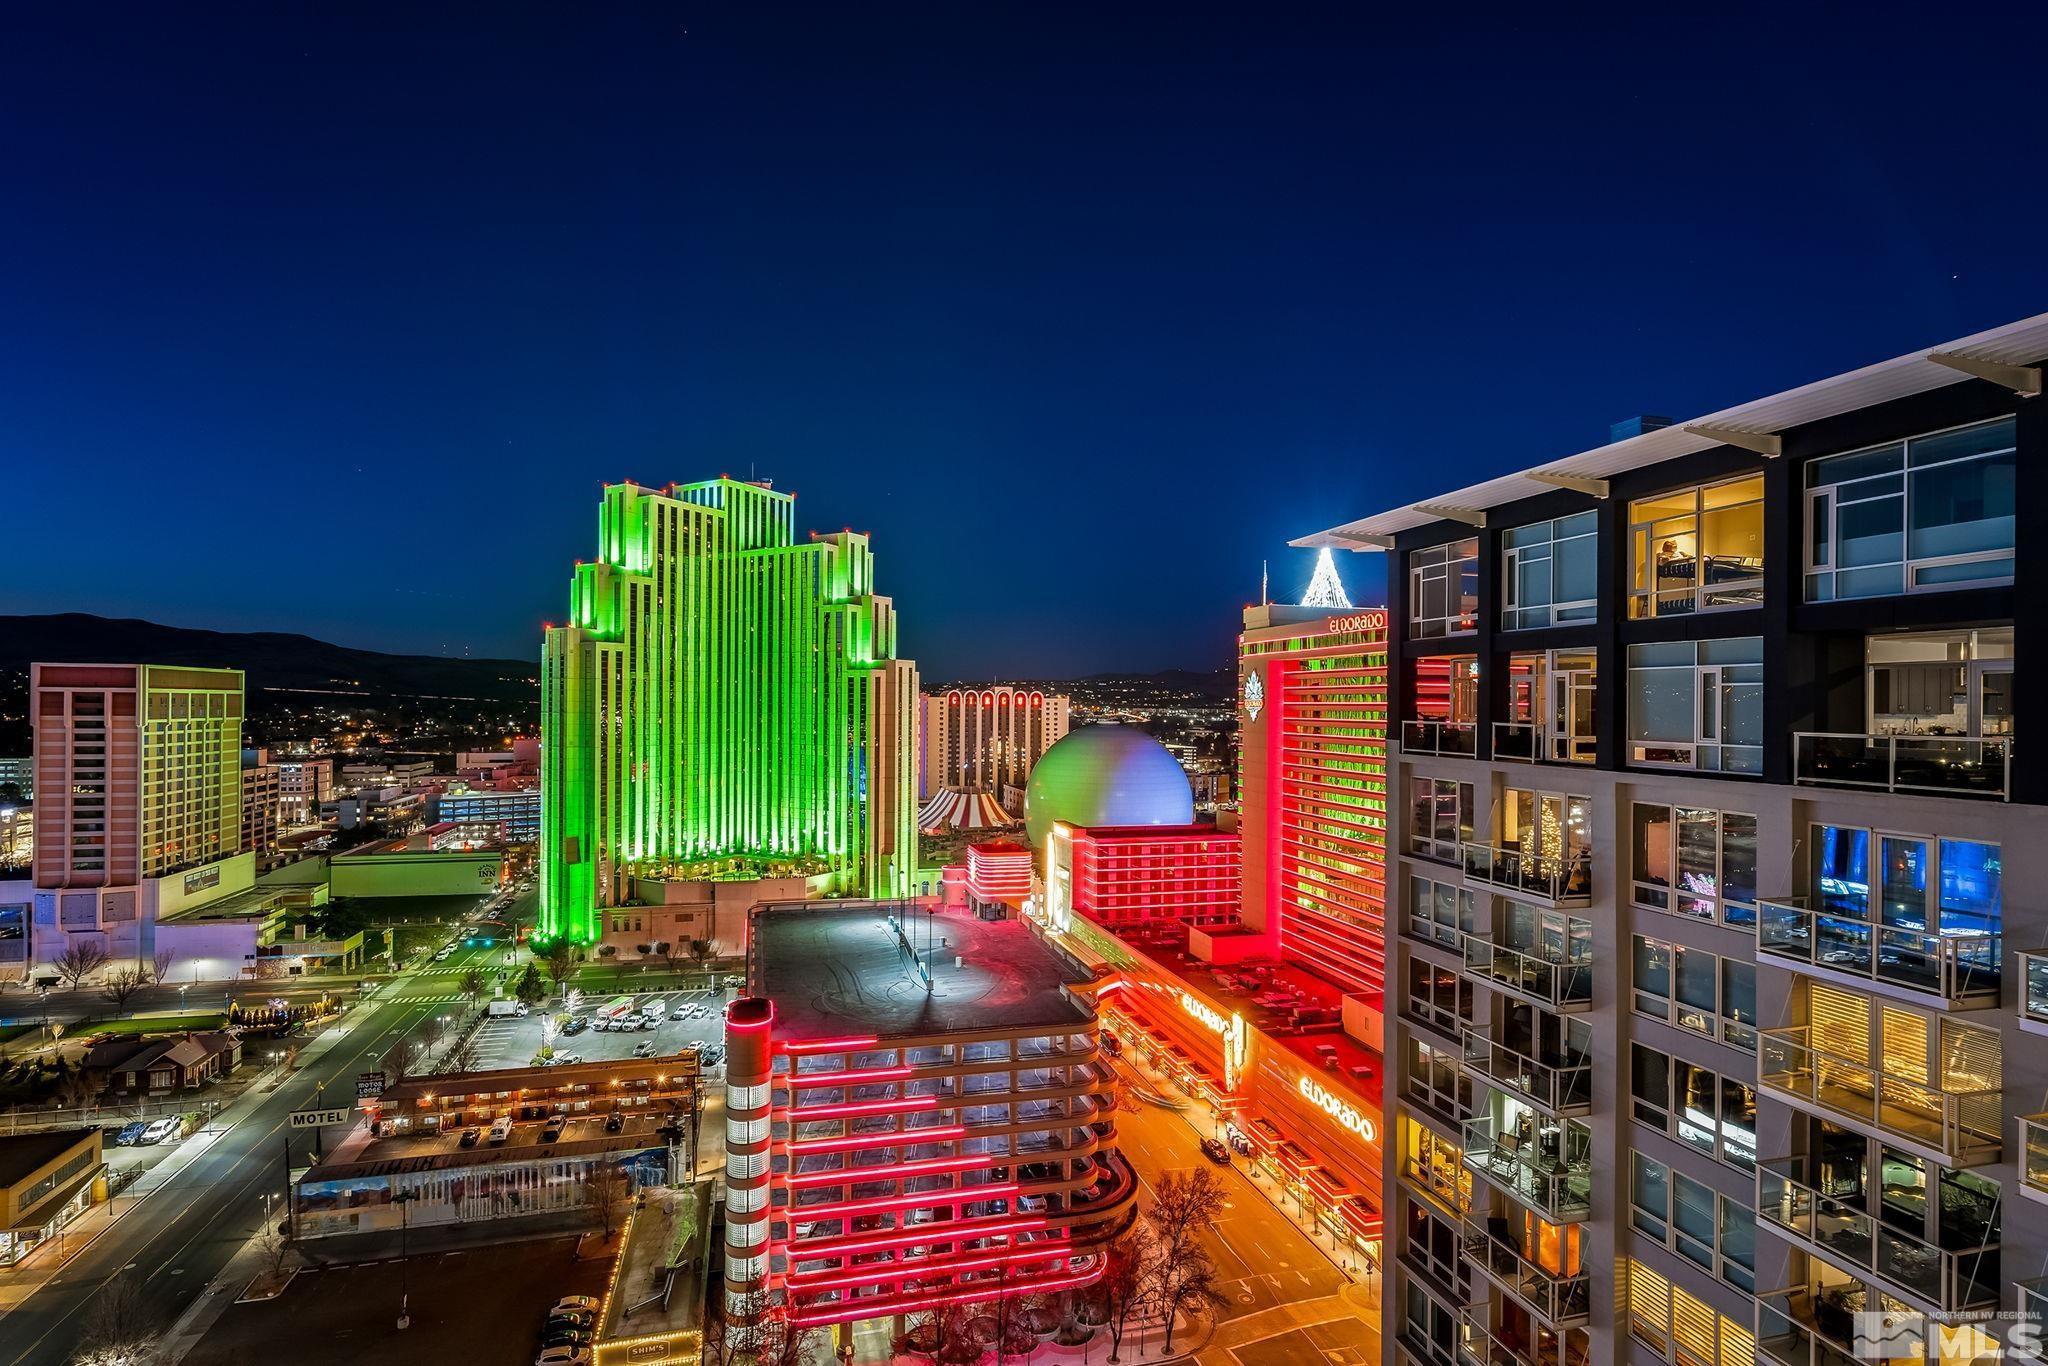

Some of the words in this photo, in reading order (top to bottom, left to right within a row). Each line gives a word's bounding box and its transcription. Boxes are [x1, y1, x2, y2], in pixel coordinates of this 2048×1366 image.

[358, 1081, 383, 1089] MOTOR
[359, 1086, 381, 1094] LODGE
[293, 1112, 343, 1125] MOTEL
[632, 1344, 665, 1354] SHIM'S
